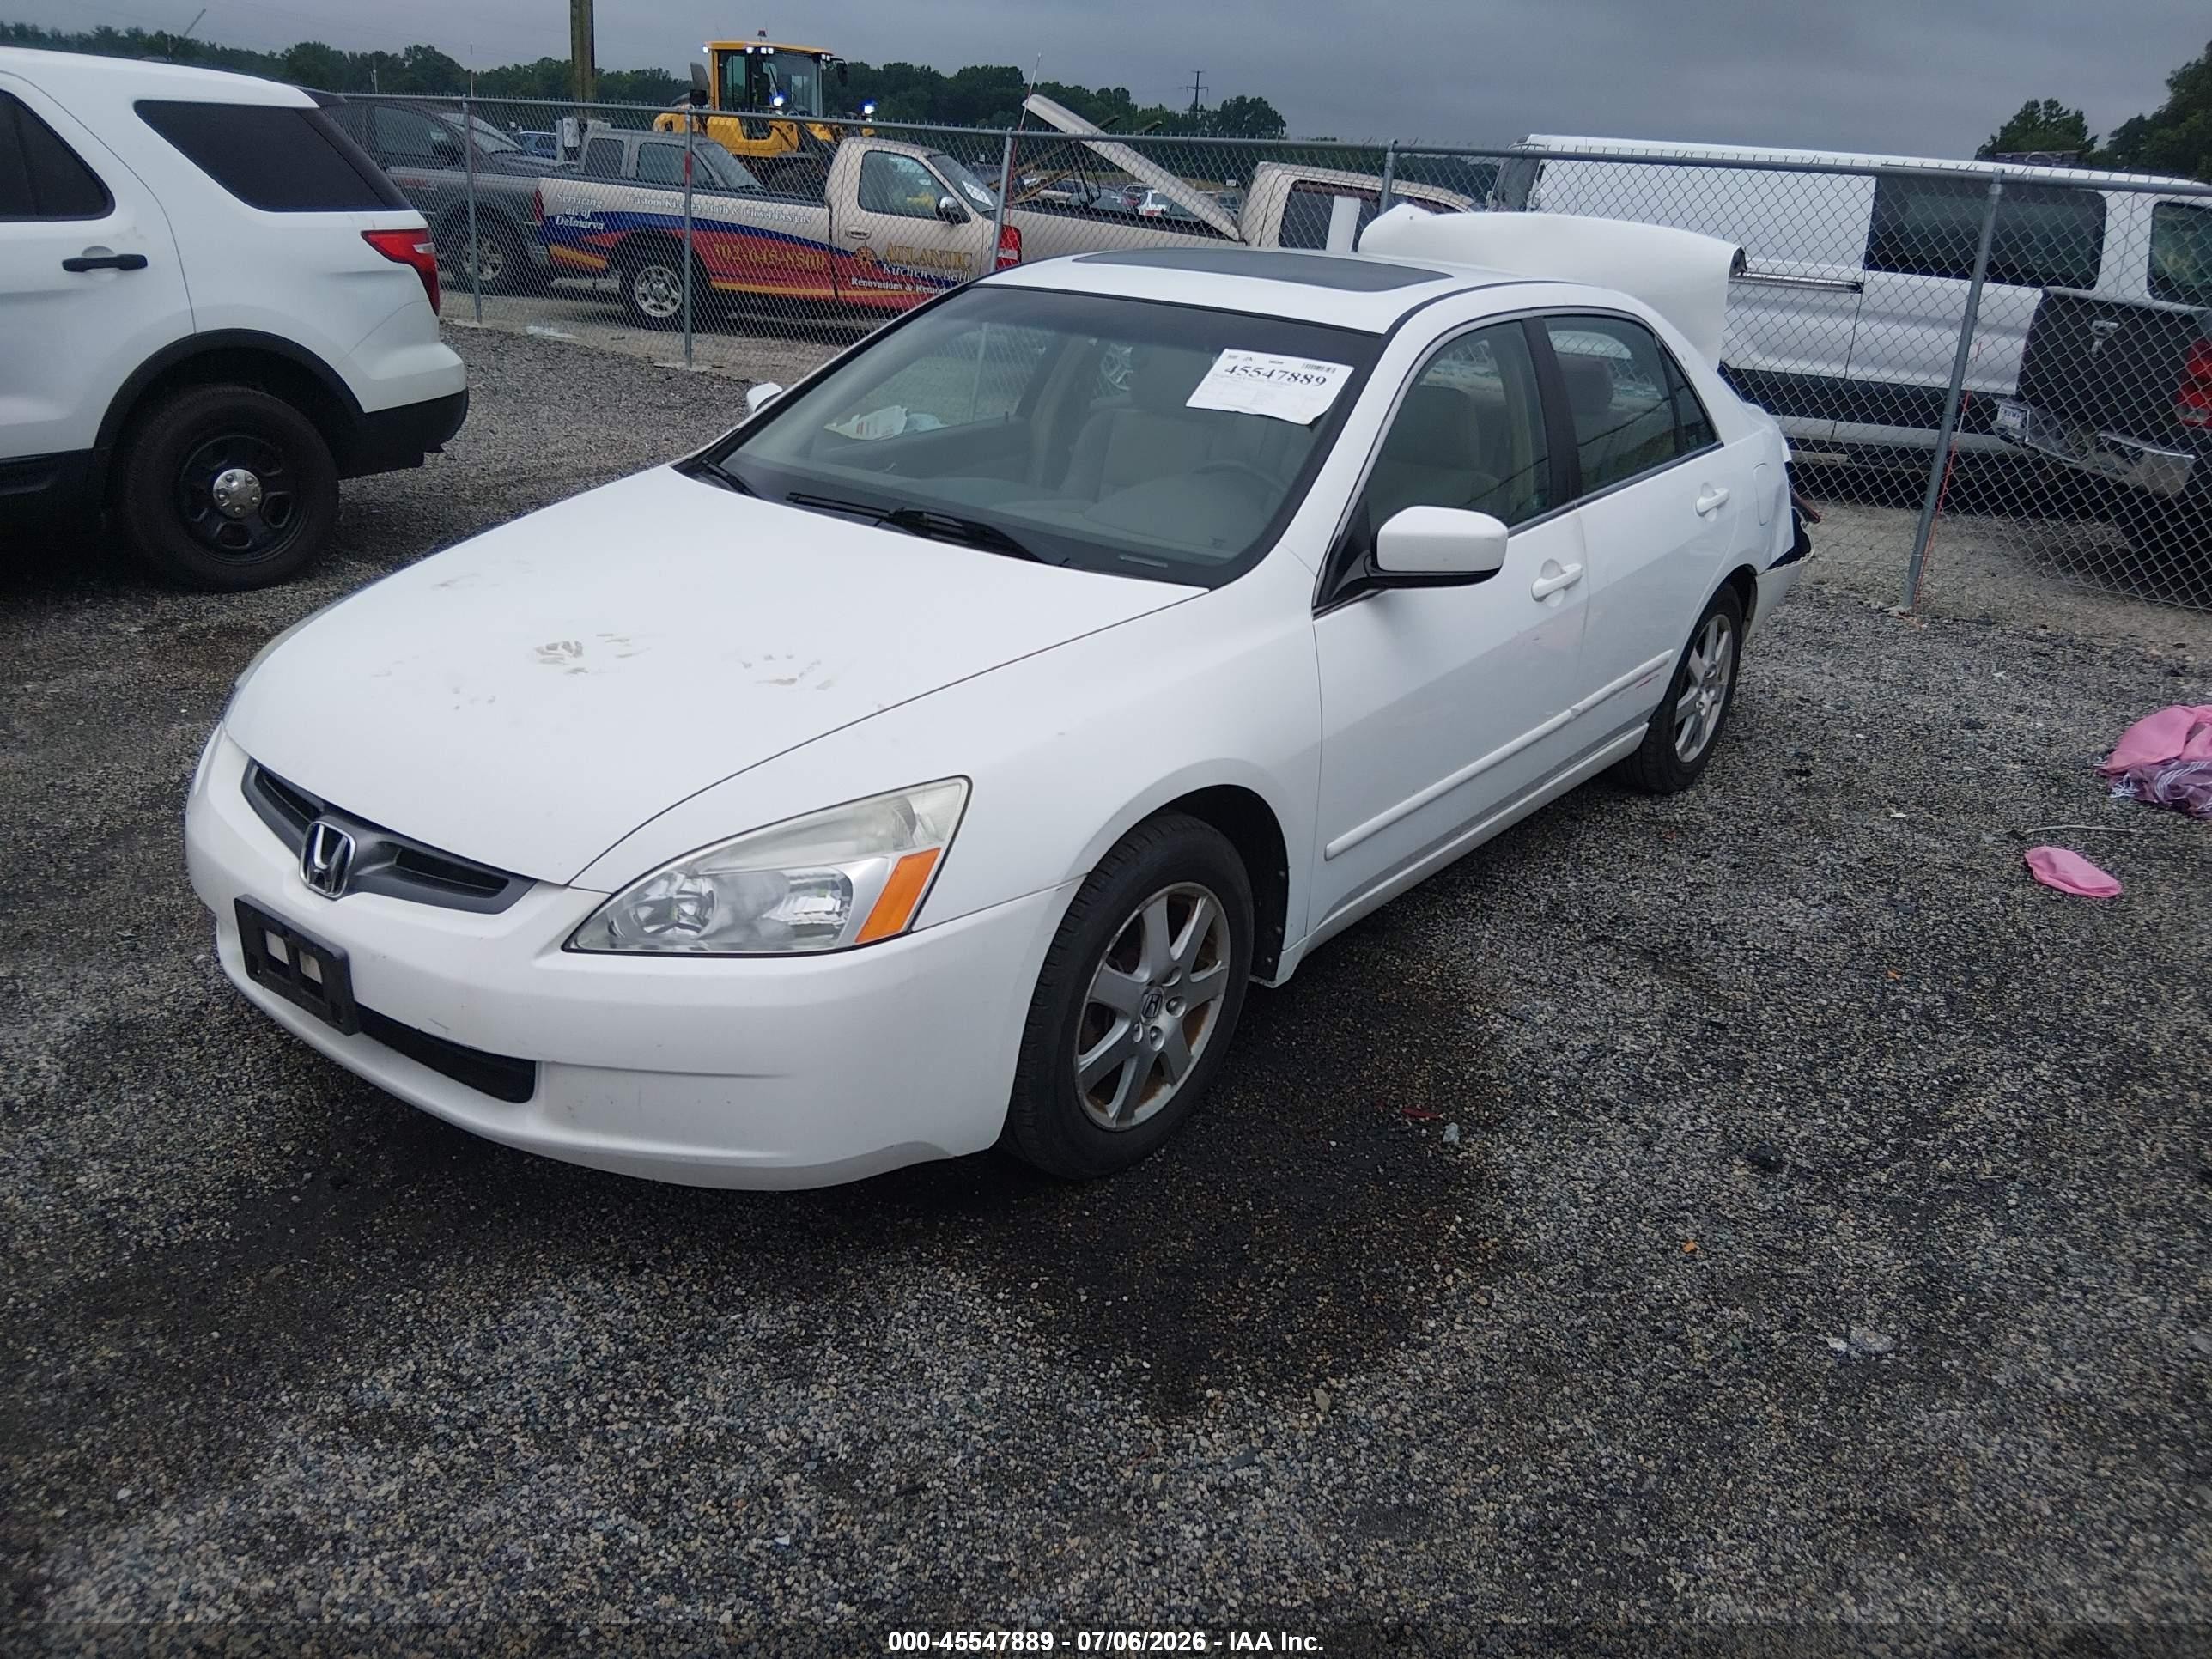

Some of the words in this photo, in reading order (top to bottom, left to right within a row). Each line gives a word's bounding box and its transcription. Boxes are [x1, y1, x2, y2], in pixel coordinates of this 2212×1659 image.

[557, 192, 603, 209] Servicing
[580, 209, 592, 217] of
[626, 194, 662, 207] Custom
[665, 198, 703, 212] Kitcen,
[775, 209, 811, 224] Designs
[556, 216, 604, 230] Delmarva
[886, 242, 974, 271] ATLANTIC
[883, 264, 928, 279] Kitchen
[851, 277, 902, 291] Renovations
[905, 284, 914, 293] &
[1224, 364, 1327, 386] 45547889
